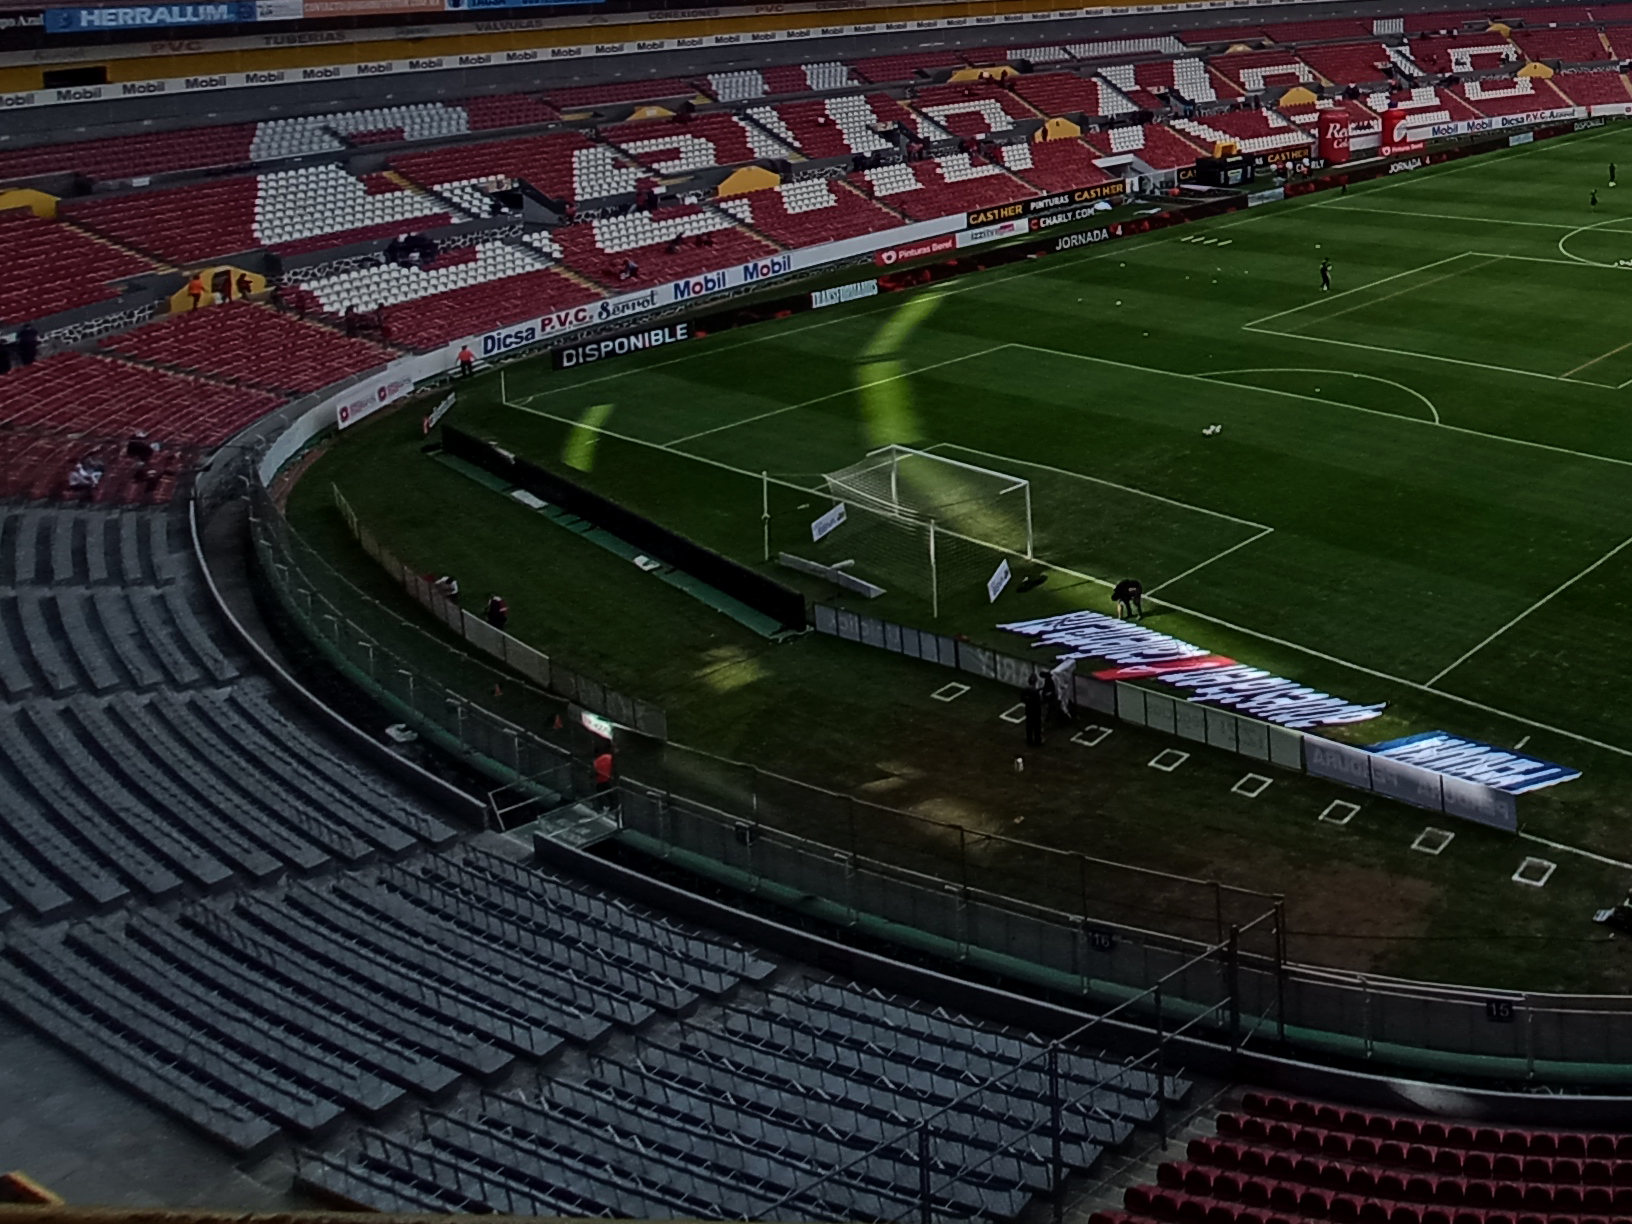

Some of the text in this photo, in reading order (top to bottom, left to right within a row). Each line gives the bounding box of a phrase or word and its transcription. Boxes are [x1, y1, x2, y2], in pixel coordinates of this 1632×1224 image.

[80, 4, 229, 26] HERRALUM
[474, 18, 544, 32] VALVULAS
[821, 26, 844, 36] Mobil
[853, 24, 876, 33] Mobil
[263, 29, 346, 46] TUBERIAS
[715, 34, 741, 45] Mobil
[752, 31, 776, 42] Mobil
[787, 29, 811, 39] Mobil
[151, 38, 202, 54] PVC
[595, 43, 624, 55] Mobil
[637, 40, 664, 52] Mobil
[676, 38, 703, 48] Mobil
[506, 50, 537, 62] Mobil
[551, 47, 582, 58] Mobil
[409, 57, 443, 70] Mobil
[459, 54, 492, 66] Mobil
[302, 67, 341, 79] Mobil
[357, 62, 393, 75] Mobil
[185, 76, 227, 90] Mobil
[245, 71, 285, 84] Mobil
[57, 87, 102, 102] Mobil
[122, 81, 165, 95] Mobil
[0, 94, 35, 107] obil
[1467, 118, 1492, 131] Mobil
[1501, 114, 1524, 126] Dicsa
[1432, 123, 1458, 136] Mobil
[1267, 149, 1308, 163] CASTHER
[1388, 156, 1431, 174] JORNADA 4
[969, 182, 1124, 225] CASTHER PINTURAS CASTHER
[1039, 206, 1096, 228] CHARLY.COM
[1055, 224, 1124, 251] JORNADA 4
[898, 245, 931, 260] Pinturas
[743, 254, 791, 283] Mobil
[673, 271, 726, 300] Mobil
[483, 325, 536, 356] Dicsa
[540, 307, 593, 333] P.V.C.
[562, 324, 688, 367] DISPONIBLE
[1094, 933, 1110, 947] 16
[1492, 1002, 1509, 1017] 15
